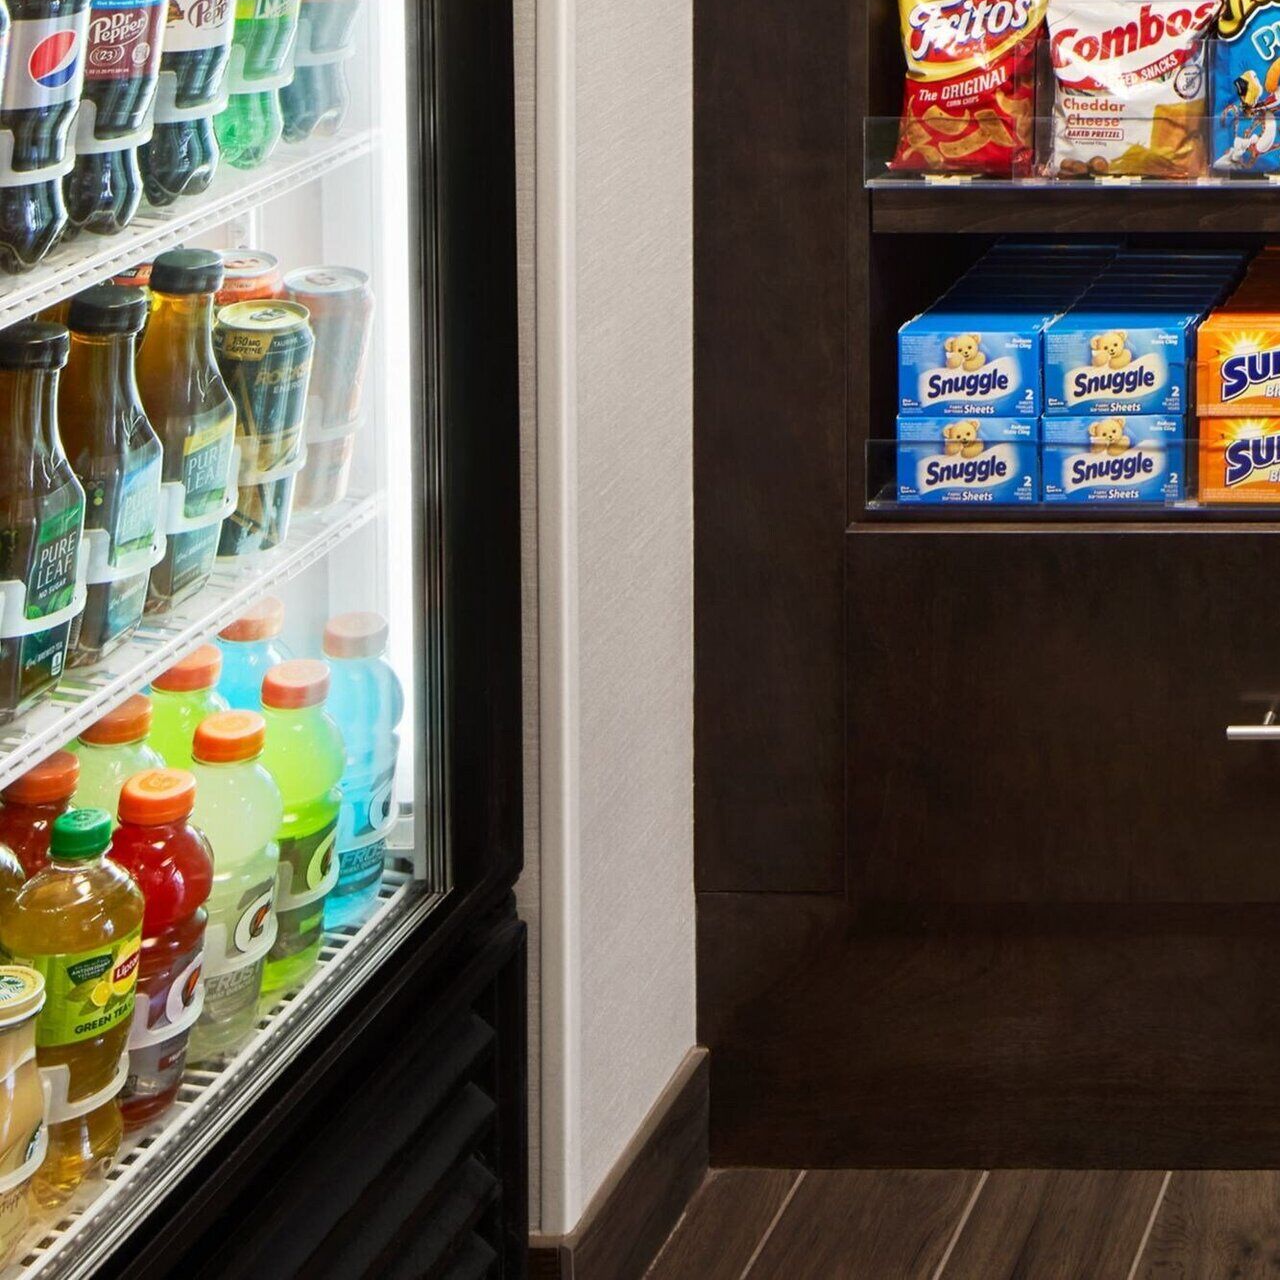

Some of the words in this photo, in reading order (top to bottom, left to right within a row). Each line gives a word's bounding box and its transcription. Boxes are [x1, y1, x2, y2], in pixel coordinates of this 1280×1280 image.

[89, 17, 146, 44] Pepper
[112, 13, 131, 28] Dr
[1052, 0, 1218, 68] Combos
[100, 50, 113, 60] 23
[1140, 54, 1177, 79] SNACKS
[1063, 98, 1125, 112] Cheddar
[1067, 114, 1120, 128] Cheese
[928, 368, 1008, 399] Snuggle
[1074, 366, 1154, 397] Snuggle
[964, 404, 994, 414] Sheets
[41, 532, 76, 561] PURE
[37, 558, 72, 589] LEAF
[116, 952, 139, 977] Lipto
[74, 1014, 111, 1035] GREEN
